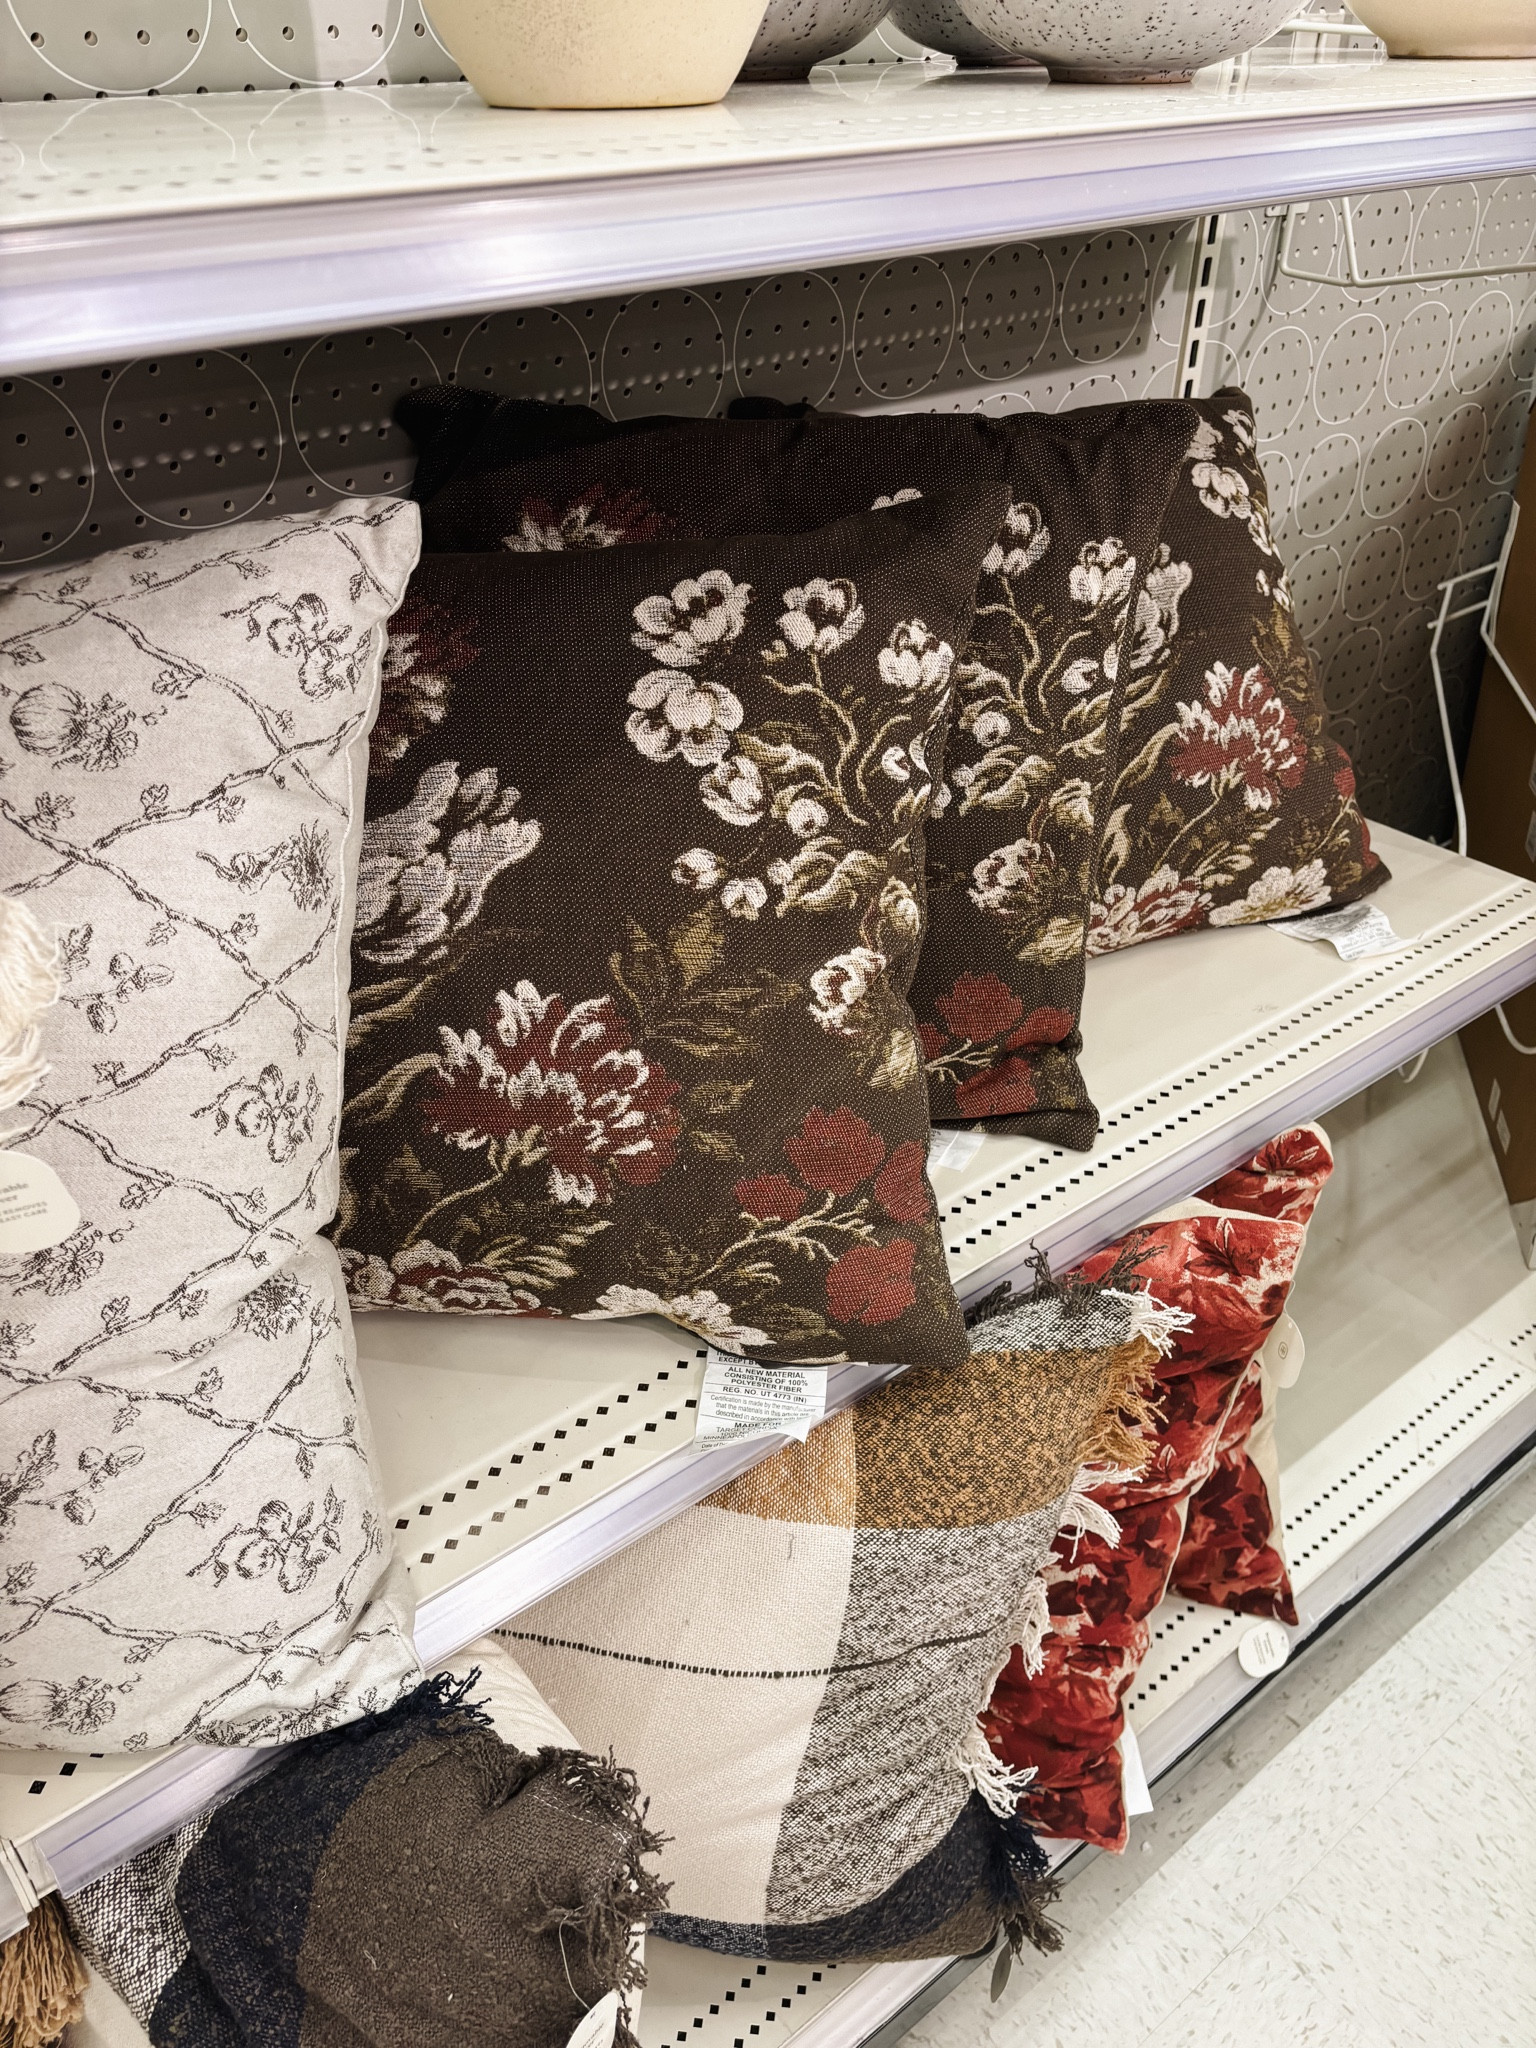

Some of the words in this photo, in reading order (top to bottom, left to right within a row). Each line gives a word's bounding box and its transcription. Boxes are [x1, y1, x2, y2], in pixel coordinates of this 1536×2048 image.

[745, 1368, 764, 1376] NEW
[765, 1371, 805, 1379] MATERIAL
[724, 1372, 773, 1383] CONSISTING
[788, 1379, 808, 1387] 100%
[722, 1386, 741, 1394] REG.
[731, 1378, 777, 1389] POLYESTER
[779, 1385, 802, 1393] FIBER
[710, 1394, 741, 1404] Certification
[764, 1401, 771, 1409] by
[715, 1409, 743, 1419] described
[738, 1405, 763, 1414] materials
